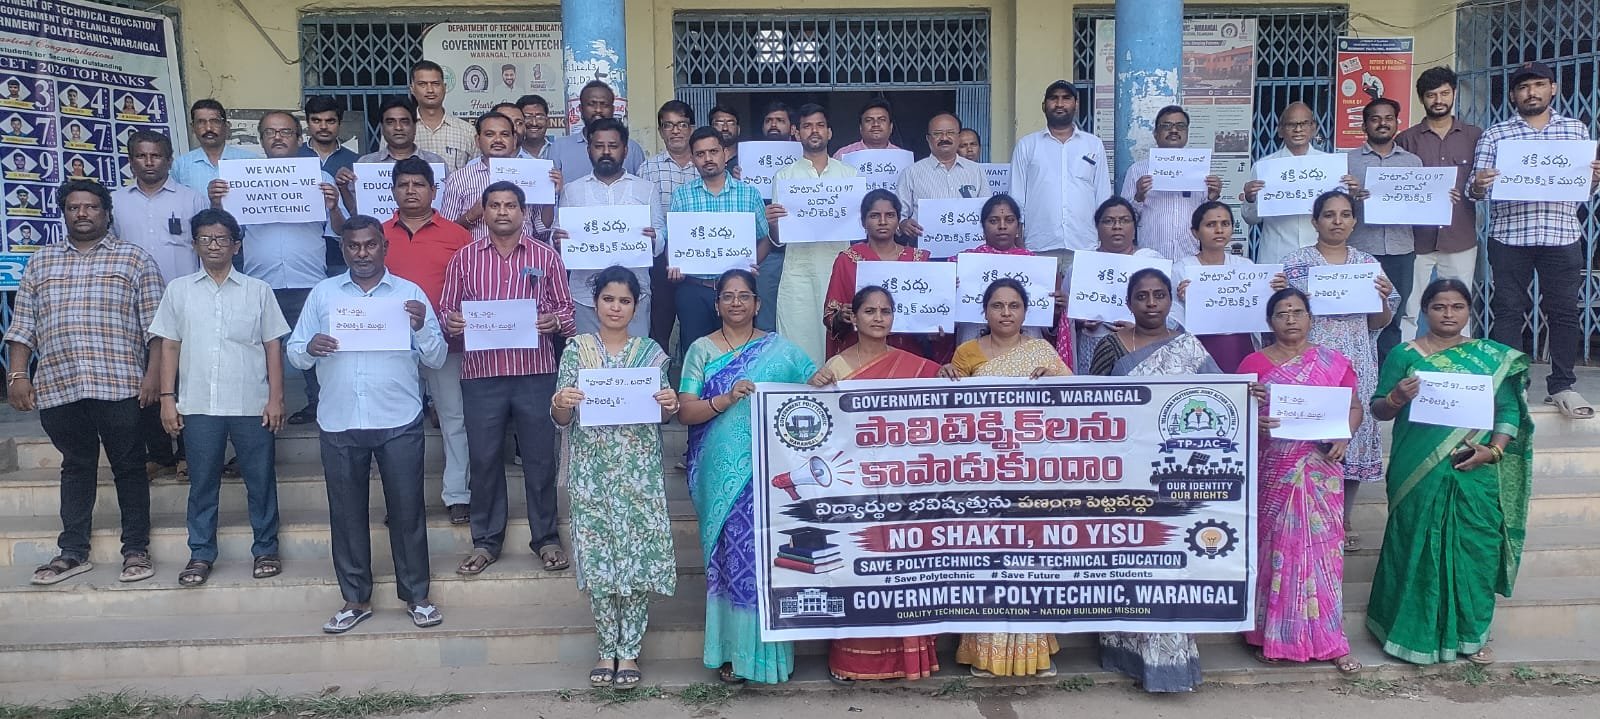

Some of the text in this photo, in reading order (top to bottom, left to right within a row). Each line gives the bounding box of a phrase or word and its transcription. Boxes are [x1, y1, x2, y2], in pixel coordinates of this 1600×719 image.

[0, 6, 60, 24] GOVERNMENT
[76, 20, 122, 36] TELANGANA
[41, 0, 53, 11] OF
[54, 4, 108, 22] TECHNICAL
[110, 16, 156, 31] EDUCATION
[448, 24, 488, 32] DEPARTMENT
[490, 24, 498, 32] OF
[500, 24, 534, 32] TECHNICAL
[442, 40, 508, 50] GOVERNMENT
[40, 62, 67, 76] 2026
[70, 67, 98, 80] TOP
[101, 71, 146, 87] RANKS
[34, 80, 51, 108] 3
[90, 88, 104, 115] 4
[146, 94, 162, 120] 4
[36, 117, 50, 144] 7
[94, 124, 106, 150] 7
[40, 152, 54, 178] 9
[246, 166, 296, 174] WE WANT
[229, 180, 289, 188] EDUCATION
[40, 187, 58, 214] 14
[246, 192, 303, 201] WANT OUR
[242, 204, 311, 214] POLYTECHNIC
[1076, 291, 1125, 306] పాలిటెక్ని
[852, 390, 1142, 409] GOVERNMENT POLYTECHNIC, WARANGAL
[860, 452, 1124, 488] కాపాడుకుందాం
[1167, 482, 1232, 490] OUR IDENTITY
[1170, 491, 1228, 499] OUR RIGHTS
[816, 500, 902, 520] విద్యార్థుల
[908, 496, 1012, 514] భవిష్యత్తును
[1018, 496, 1082, 510] పణంగా
[890, 523, 1144, 550] NO SHAKTI, NO YISU
[860, 554, 1182, 572] SAVE POLYTECHNICS SAVE TECHNICAL EDUCATION
[920, 572, 975, 584] Polytechnic
[1028, 571, 1060, 579] Future
[1110, 570, 1152, 578] Students
[854, 585, 1238, 610] GOVERNMENT POLYTECHNIC, WARANGAL
[897, 610, 932, 618] QUALITY
[1115, 606, 1150, 614] MISSION
